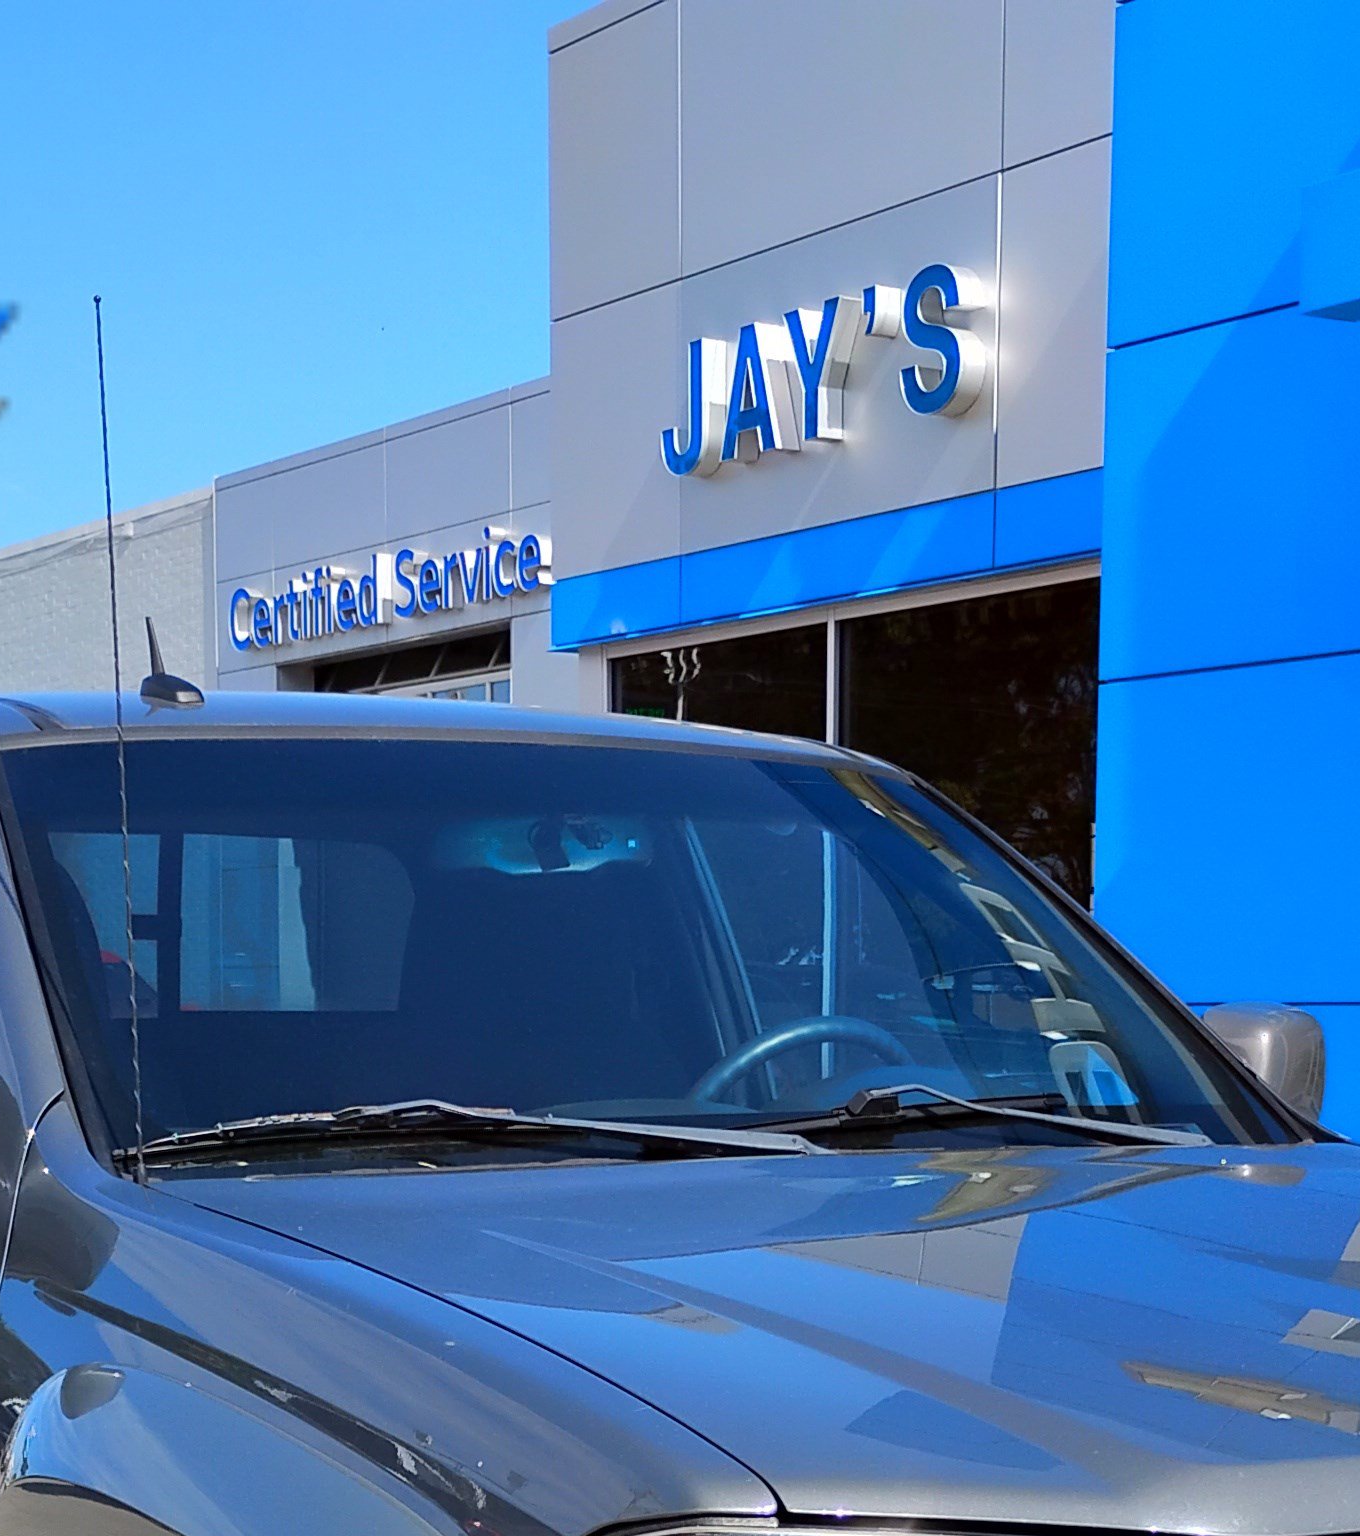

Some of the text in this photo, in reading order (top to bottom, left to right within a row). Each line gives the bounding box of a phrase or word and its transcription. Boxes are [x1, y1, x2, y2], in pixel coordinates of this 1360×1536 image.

[660, 262, 986, 478] JAY'S
[228, 525, 547, 653] Certified Service
